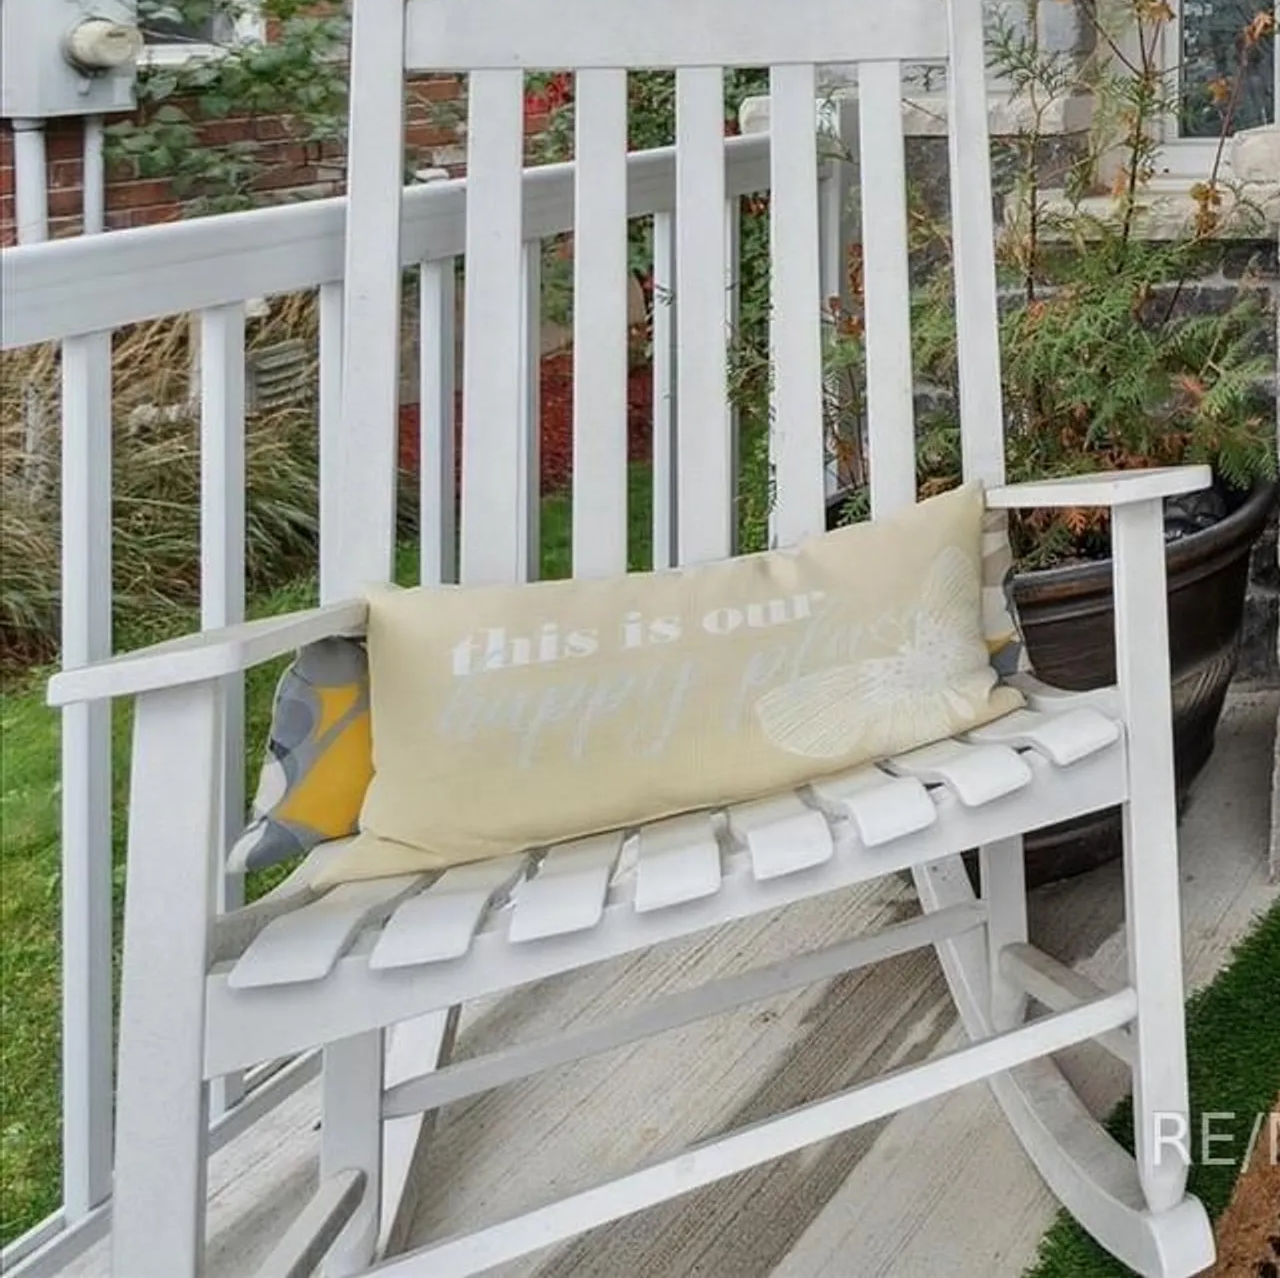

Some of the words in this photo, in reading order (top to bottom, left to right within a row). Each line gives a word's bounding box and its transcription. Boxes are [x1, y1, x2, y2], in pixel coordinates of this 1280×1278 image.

[451, 624, 599, 676] this
[622, 611, 682, 649] is
[702, 590, 827, 636] our
